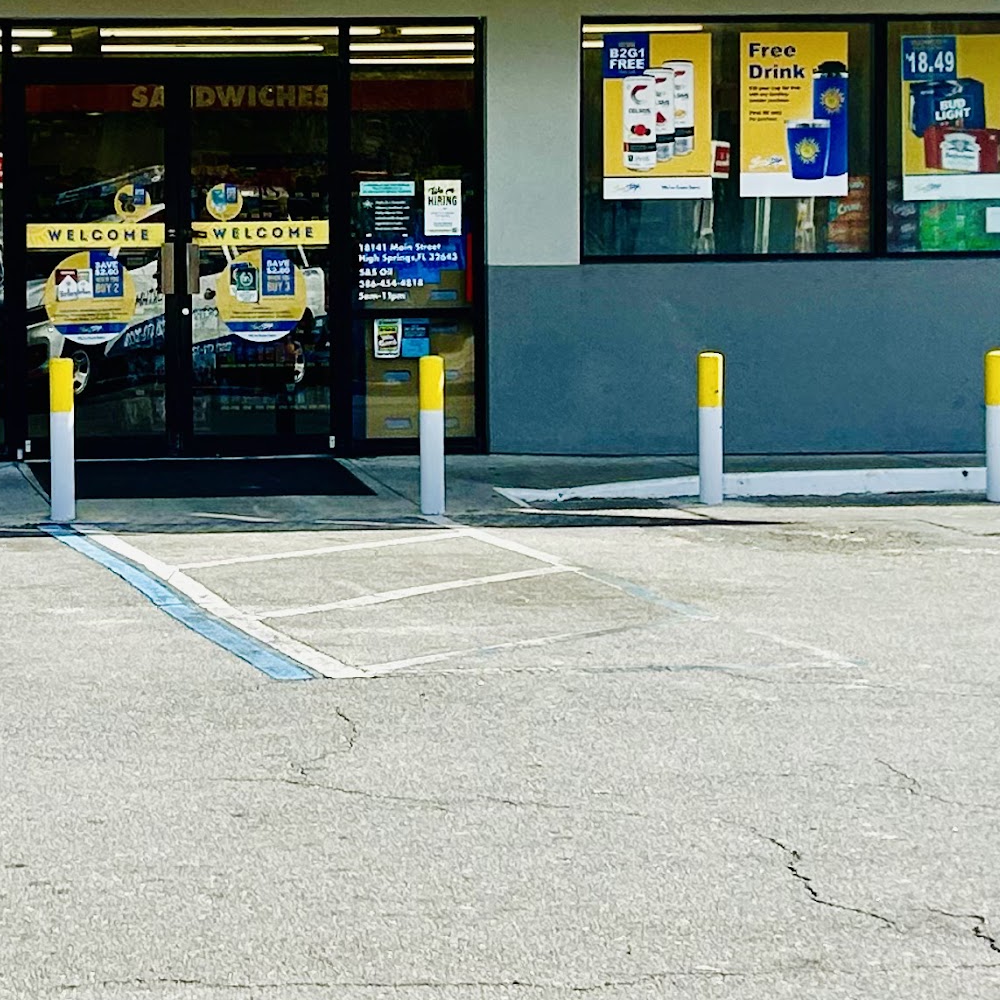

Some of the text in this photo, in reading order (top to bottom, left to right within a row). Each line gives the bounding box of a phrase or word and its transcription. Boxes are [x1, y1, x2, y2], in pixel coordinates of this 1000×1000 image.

[609, 48, 645, 59] B2G1
[748, 42, 796, 58] Free
[609, 59, 645, 70] FREE
[905, 51, 955, 73] $18.49
[748, 64, 805, 79] Drink
[131, 85, 328, 108] SADWICHES
[940, 98, 966, 111] BUD
[935, 107, 971, 121] LIGHT
[427, 196, 457, 206] HIRING
[48, 228, 150, 242] WELCOME
[213, 227, 314, 240] WELCOME
[358, 243, 441, 252] 18141 Main Street
[267, 259, 290, 267] SAVE
[358, 254, 380, 264] High
[428, 252, 458, 261] 32643
[95, 261, 119, 269] SAVE
[95, 283, 120, 293] BUY 2
